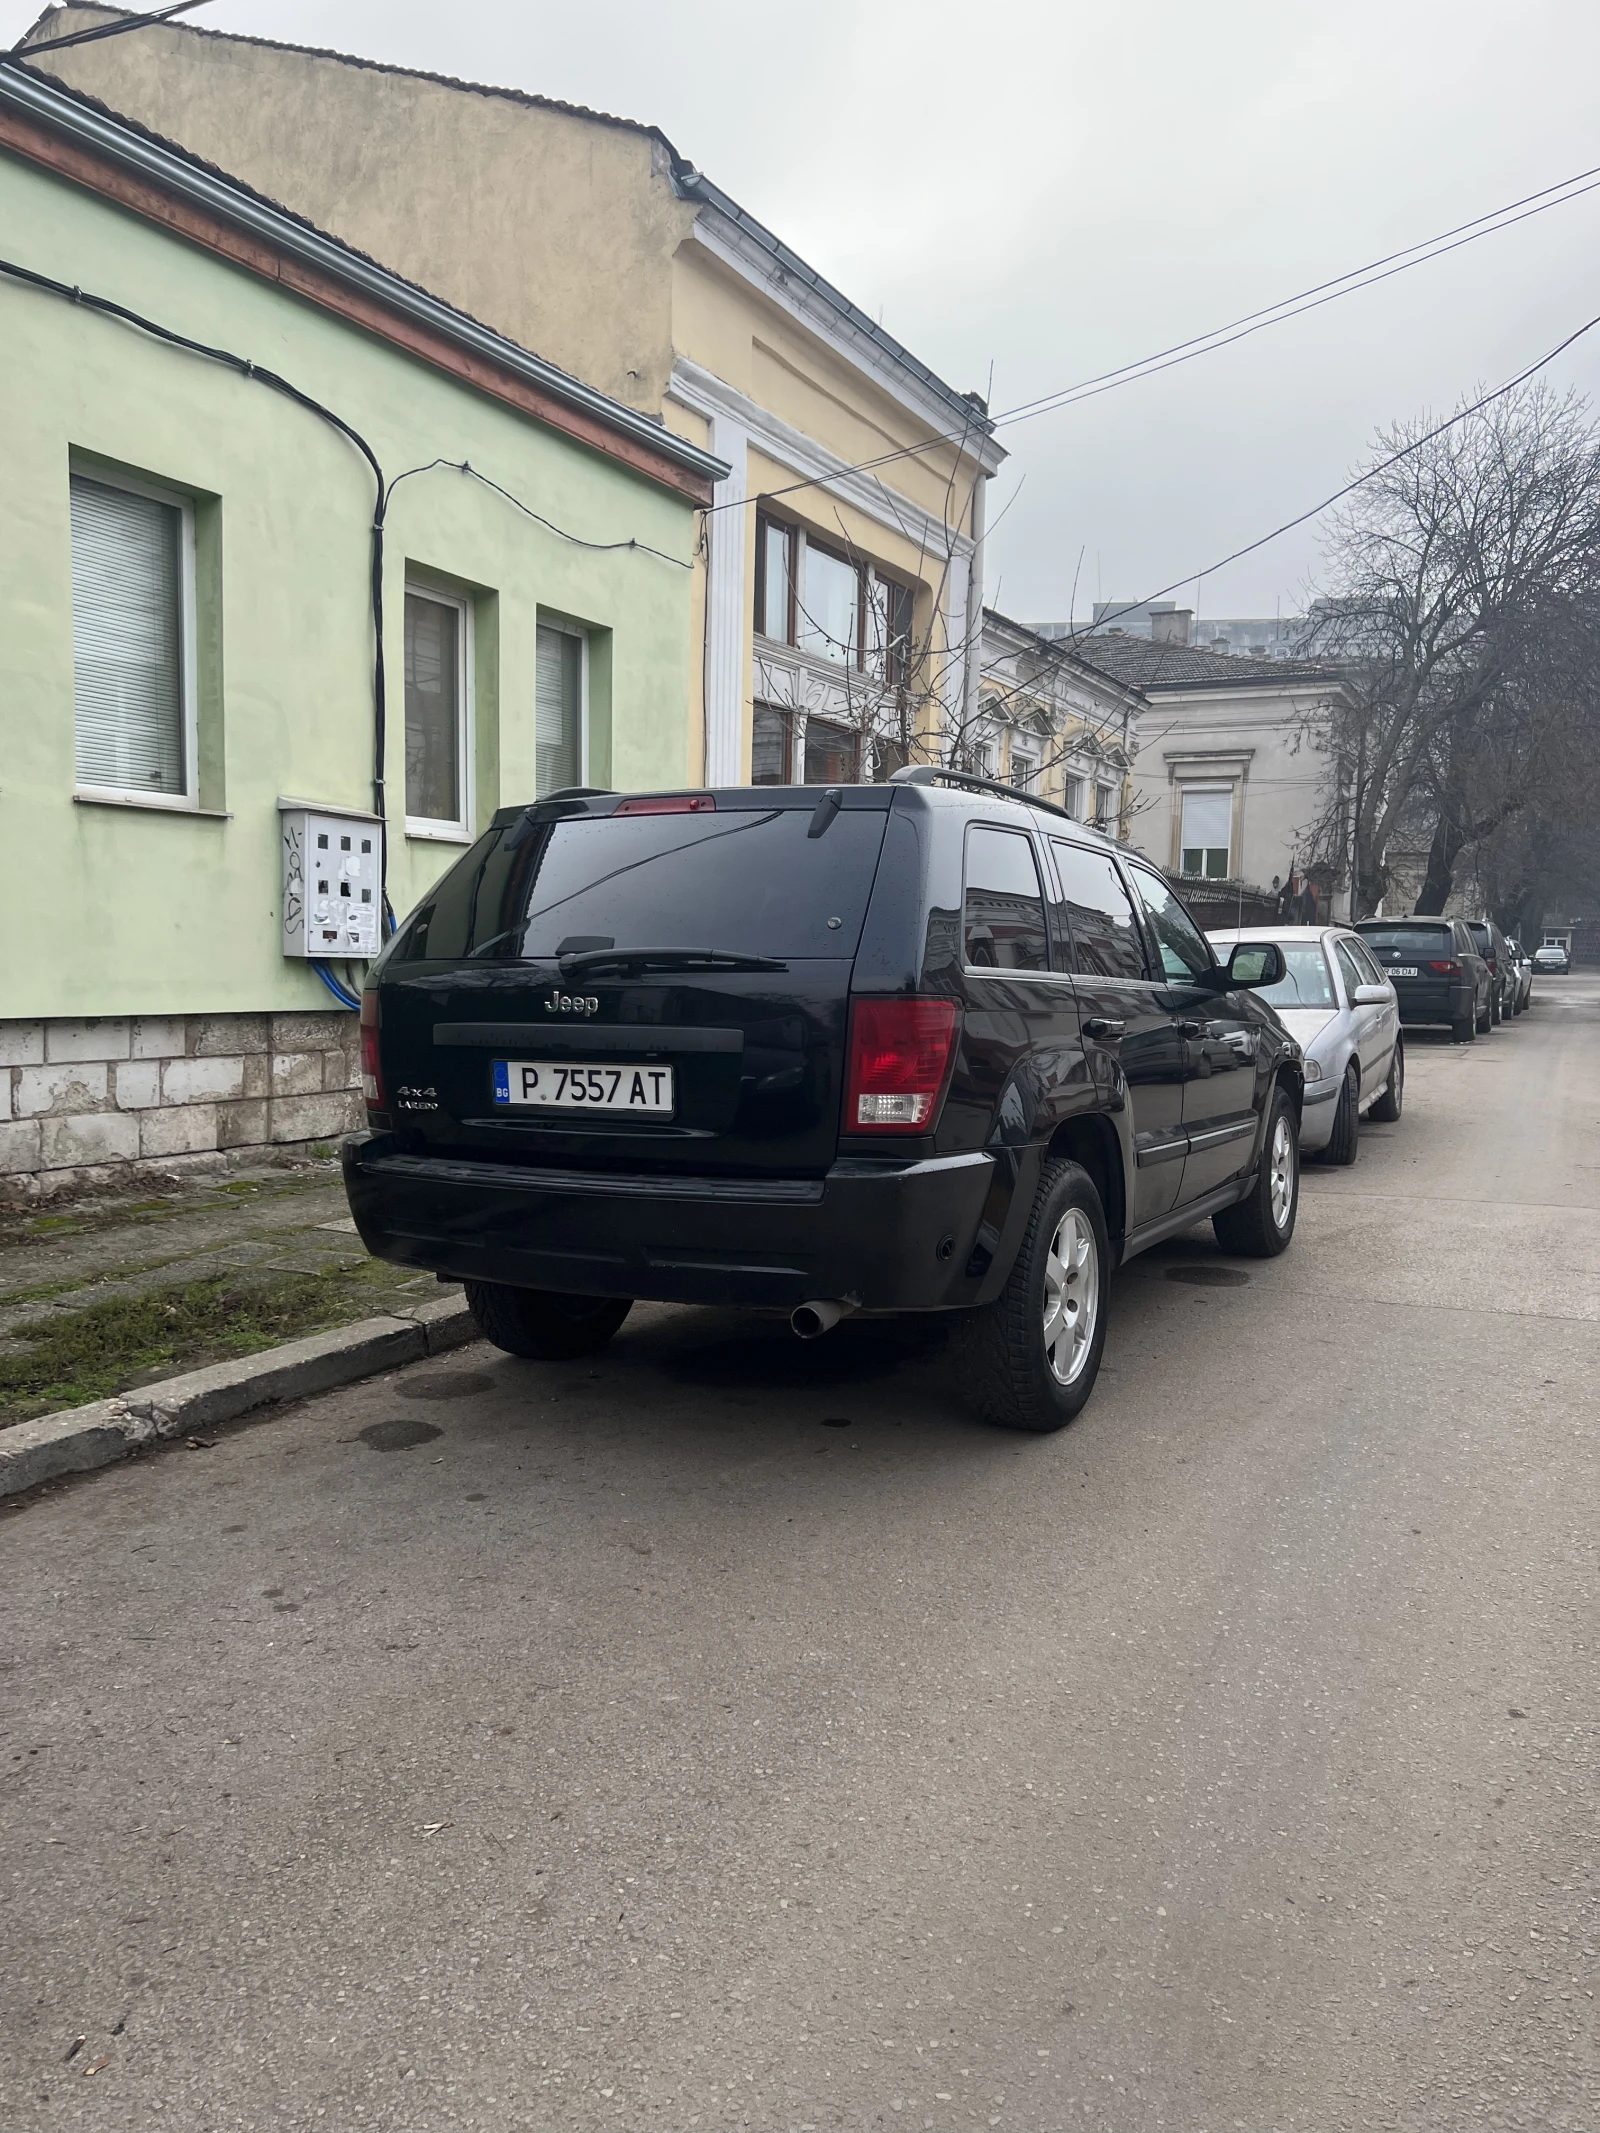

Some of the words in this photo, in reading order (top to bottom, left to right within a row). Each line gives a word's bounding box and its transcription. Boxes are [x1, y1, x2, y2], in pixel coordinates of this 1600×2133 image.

[544, 991, 599, 1017] Jeep
[496, 1088, 508, 1098] BG
[522, 1067, 539, 1099] P
[553, 1069, 622, 1103] 7557
[629, 1071, 667, 1105] AT
[398, 1101, 438, 1110] LAREDO
